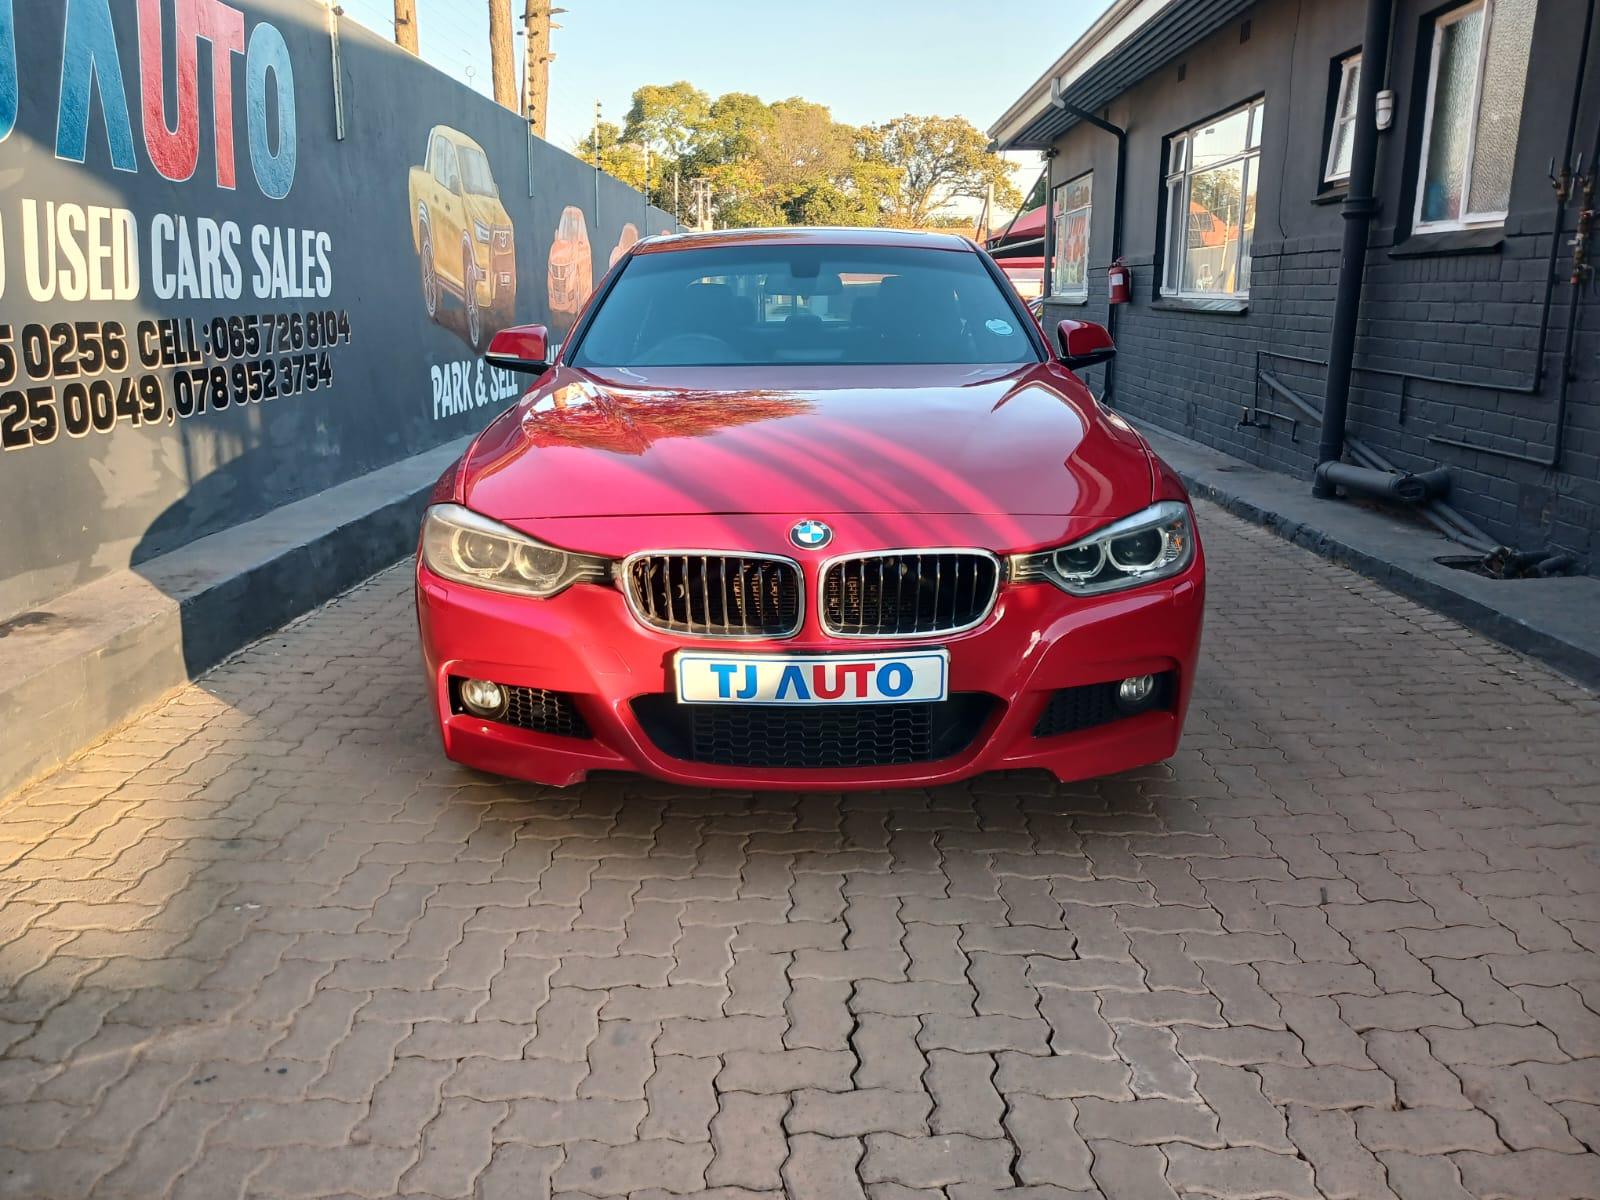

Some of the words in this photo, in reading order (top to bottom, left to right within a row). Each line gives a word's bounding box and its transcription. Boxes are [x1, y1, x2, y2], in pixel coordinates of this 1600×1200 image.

[22, 198, 140, 302] USED
[151, 213, 243, 300] CARS
[252, 223, 332, 299] SALES
[22, 322, 129, 381] 0256
[262, 312, 304, 355] 726
[306, 309, 351, 350] 8104
[232, 359, 278, 406] 952
[279, 351, 333, 397] 3754
[431, 360, 473, 420] PARK
[475, 358, 488, 407] &
[490, 365, 518, 402] SELL
[710, 664, 757, 699] TJ
[775, 662, 913, 699] AUTO
